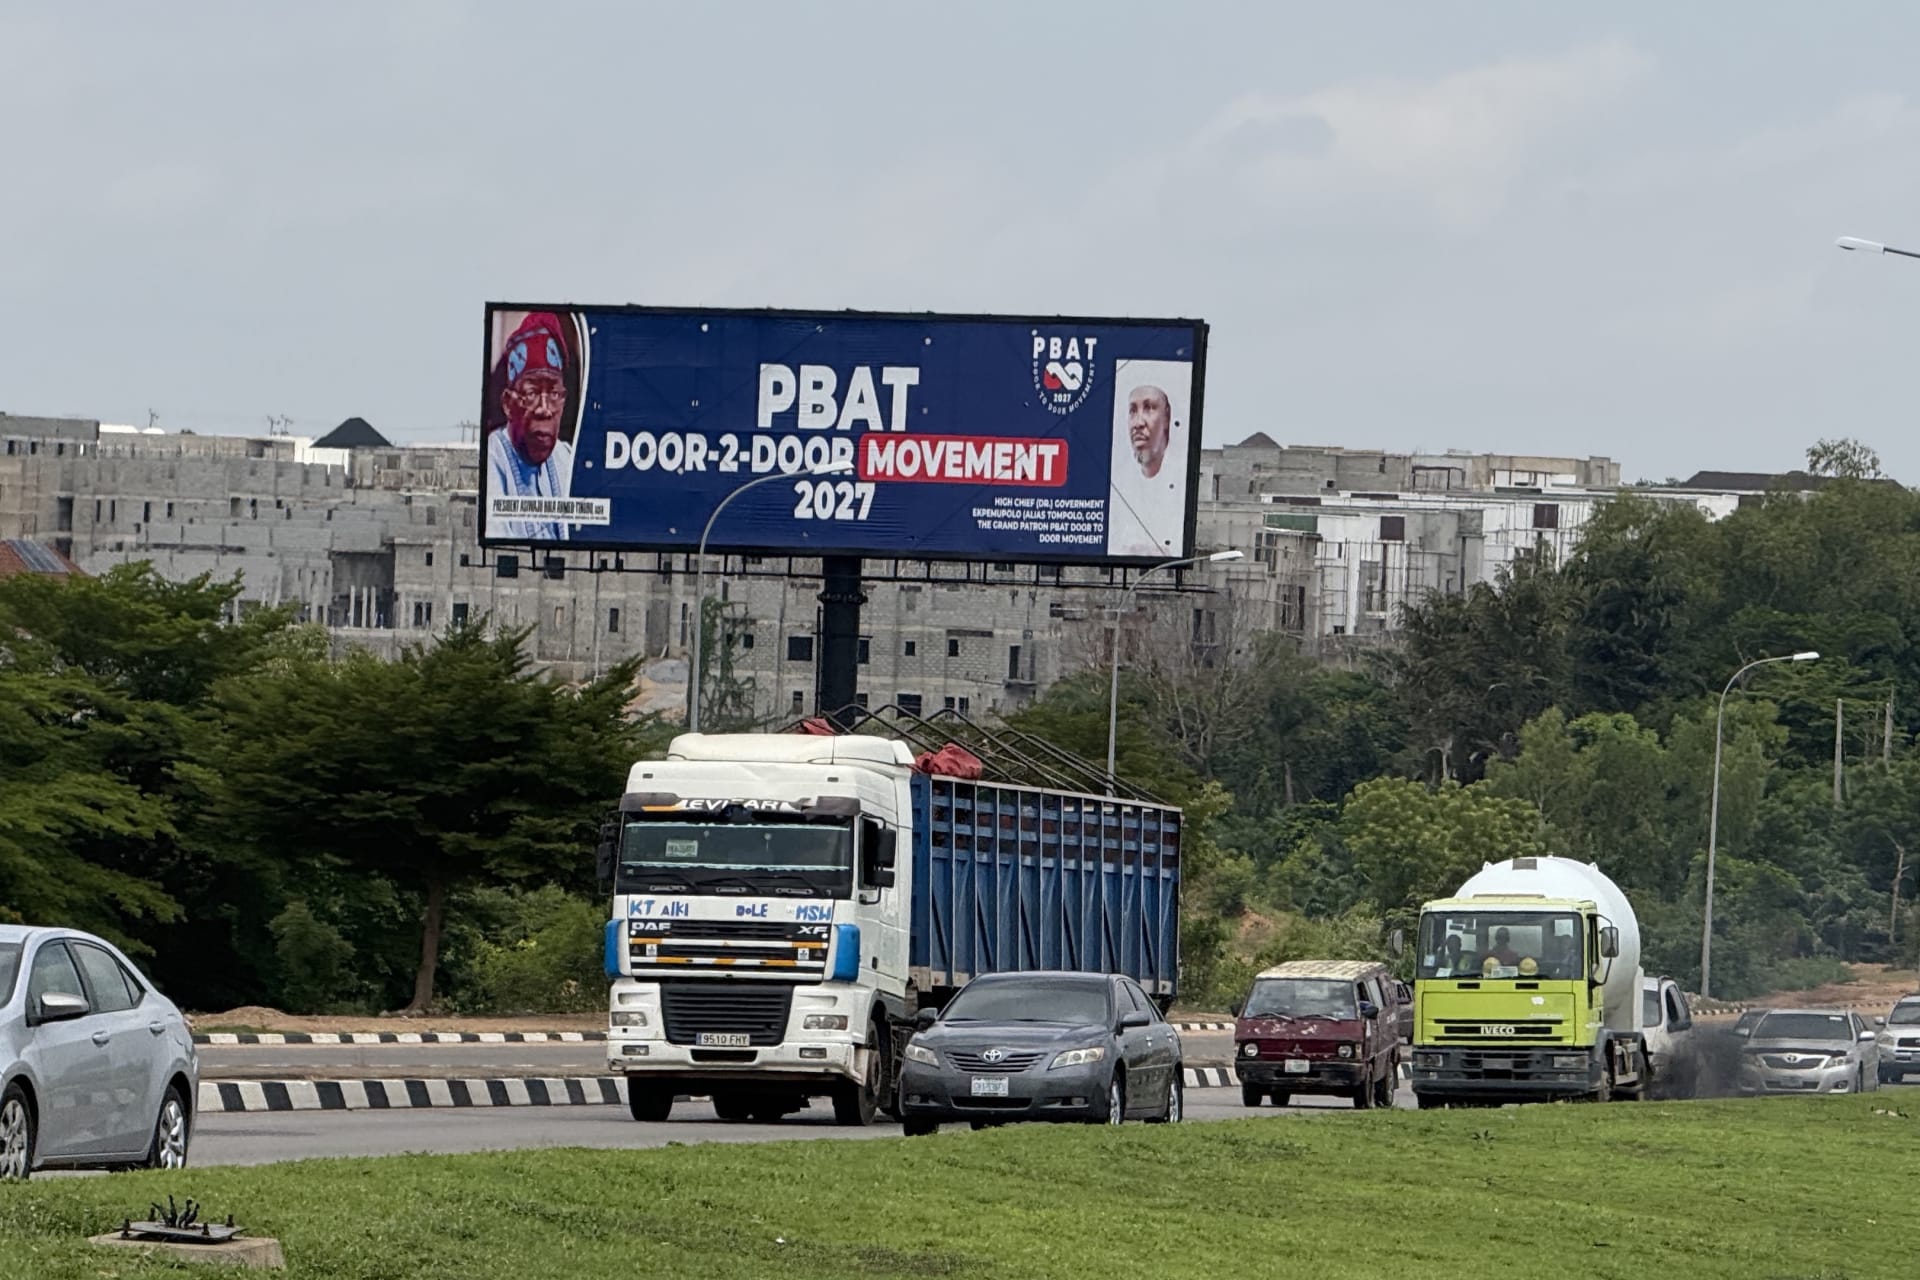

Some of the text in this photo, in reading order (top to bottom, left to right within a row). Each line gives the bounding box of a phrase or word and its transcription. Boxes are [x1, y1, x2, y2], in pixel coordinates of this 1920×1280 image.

[1032, 336, 1097, 360] PBAT
[757, 362, 920, 431] PBAT
[1053, 393, 1072, 403] 2027
[604, 430, 1060, 481] DOOR-2-DOOR MOVEMENT
[794, 480, 876, 521] 2027
[994, 497, 1013, 506] HIGH
[1014, 498, 1035, 507] CHIEF
[1054, 499, 1104, 508] GOVERNMENT
[1022, 510, 1046, 521] (ALIAS
[977, 519, 992, 529] THE
[992, 520, 1019, 530] GRAND
[1020, 521, 1049, 531] PATRON
[1070, 523, 1092, 532] DOOR
[1092, 523, 1104, 532] TO
[1039, 533, 1103, 544] DOOR MOVEMENT
[631, 922, 671, 931] DAF
[797, 926, 828, 935] XF
[1480, 1026, 1515, 1036] IVECO
